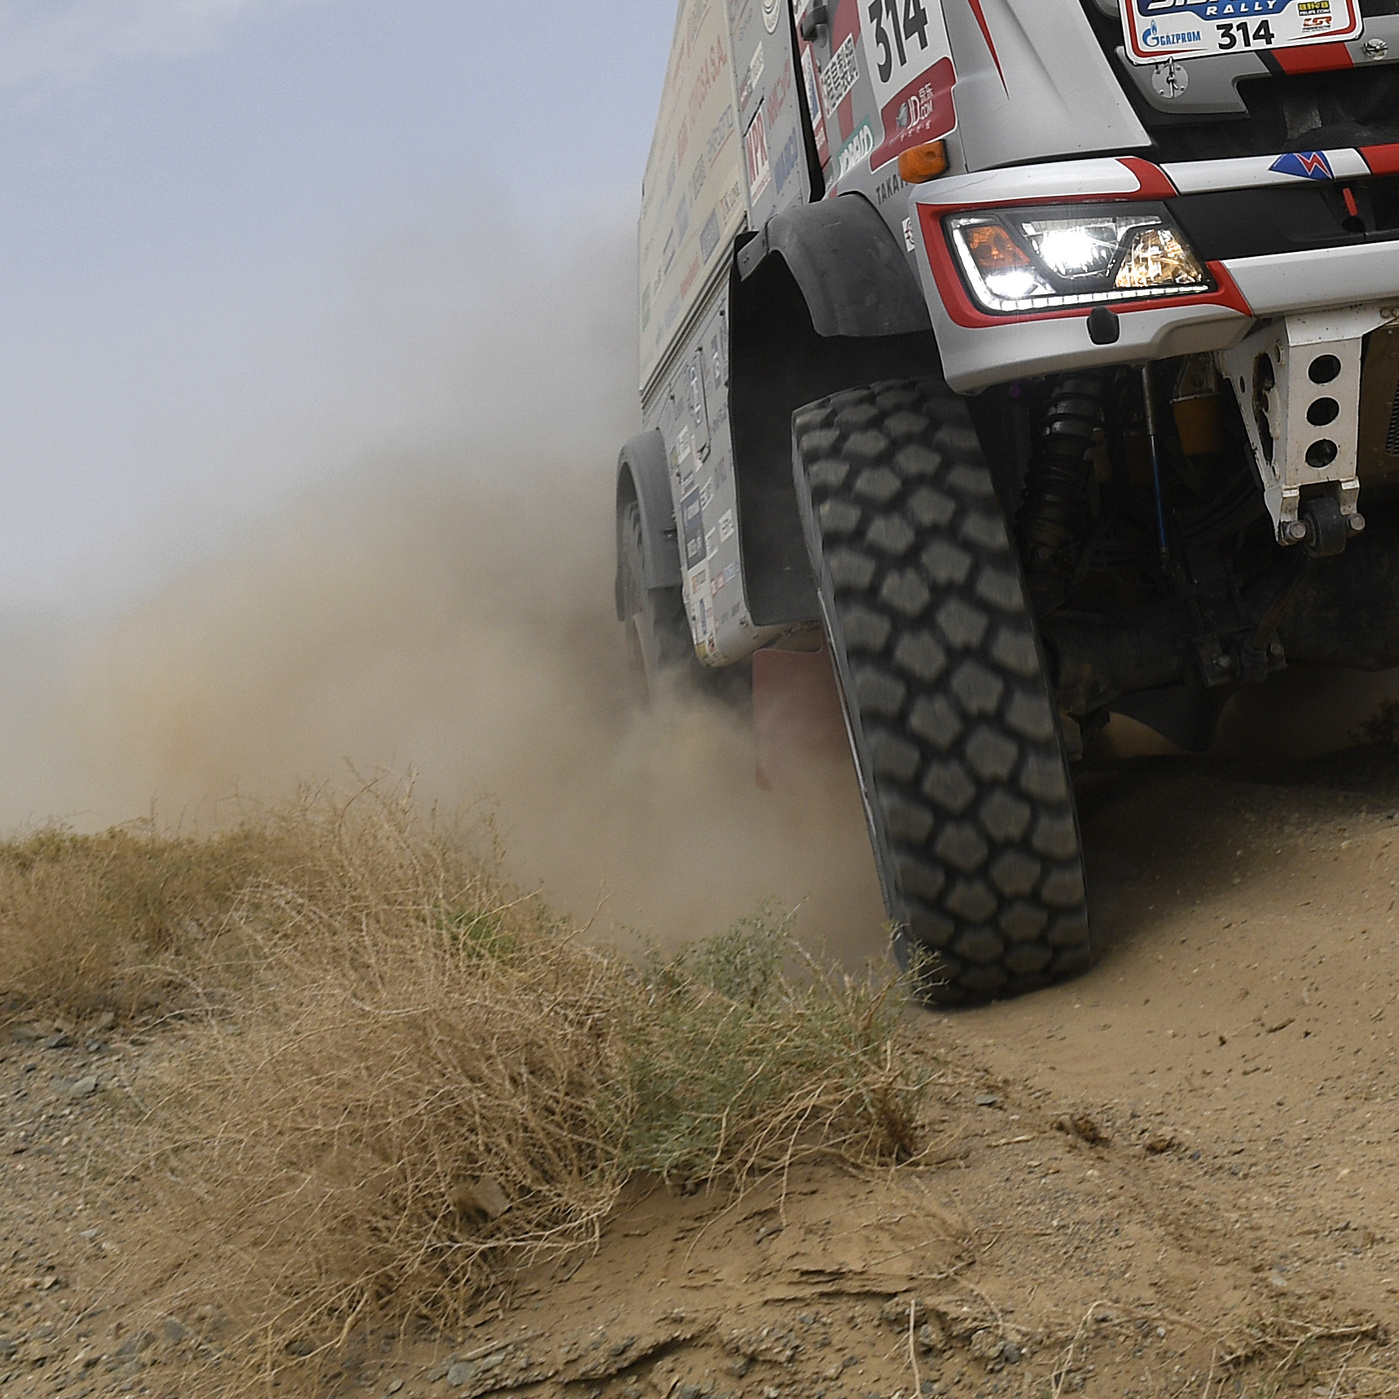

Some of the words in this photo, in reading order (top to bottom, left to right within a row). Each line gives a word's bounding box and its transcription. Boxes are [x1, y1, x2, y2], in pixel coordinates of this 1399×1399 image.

[1206, 0, 1278, 16] RALLY
[1160, 31, 1202, 46] GAZPROM
[1216, 19, 1275, 50] 314
[875, 173, 909, 205] TAKA
